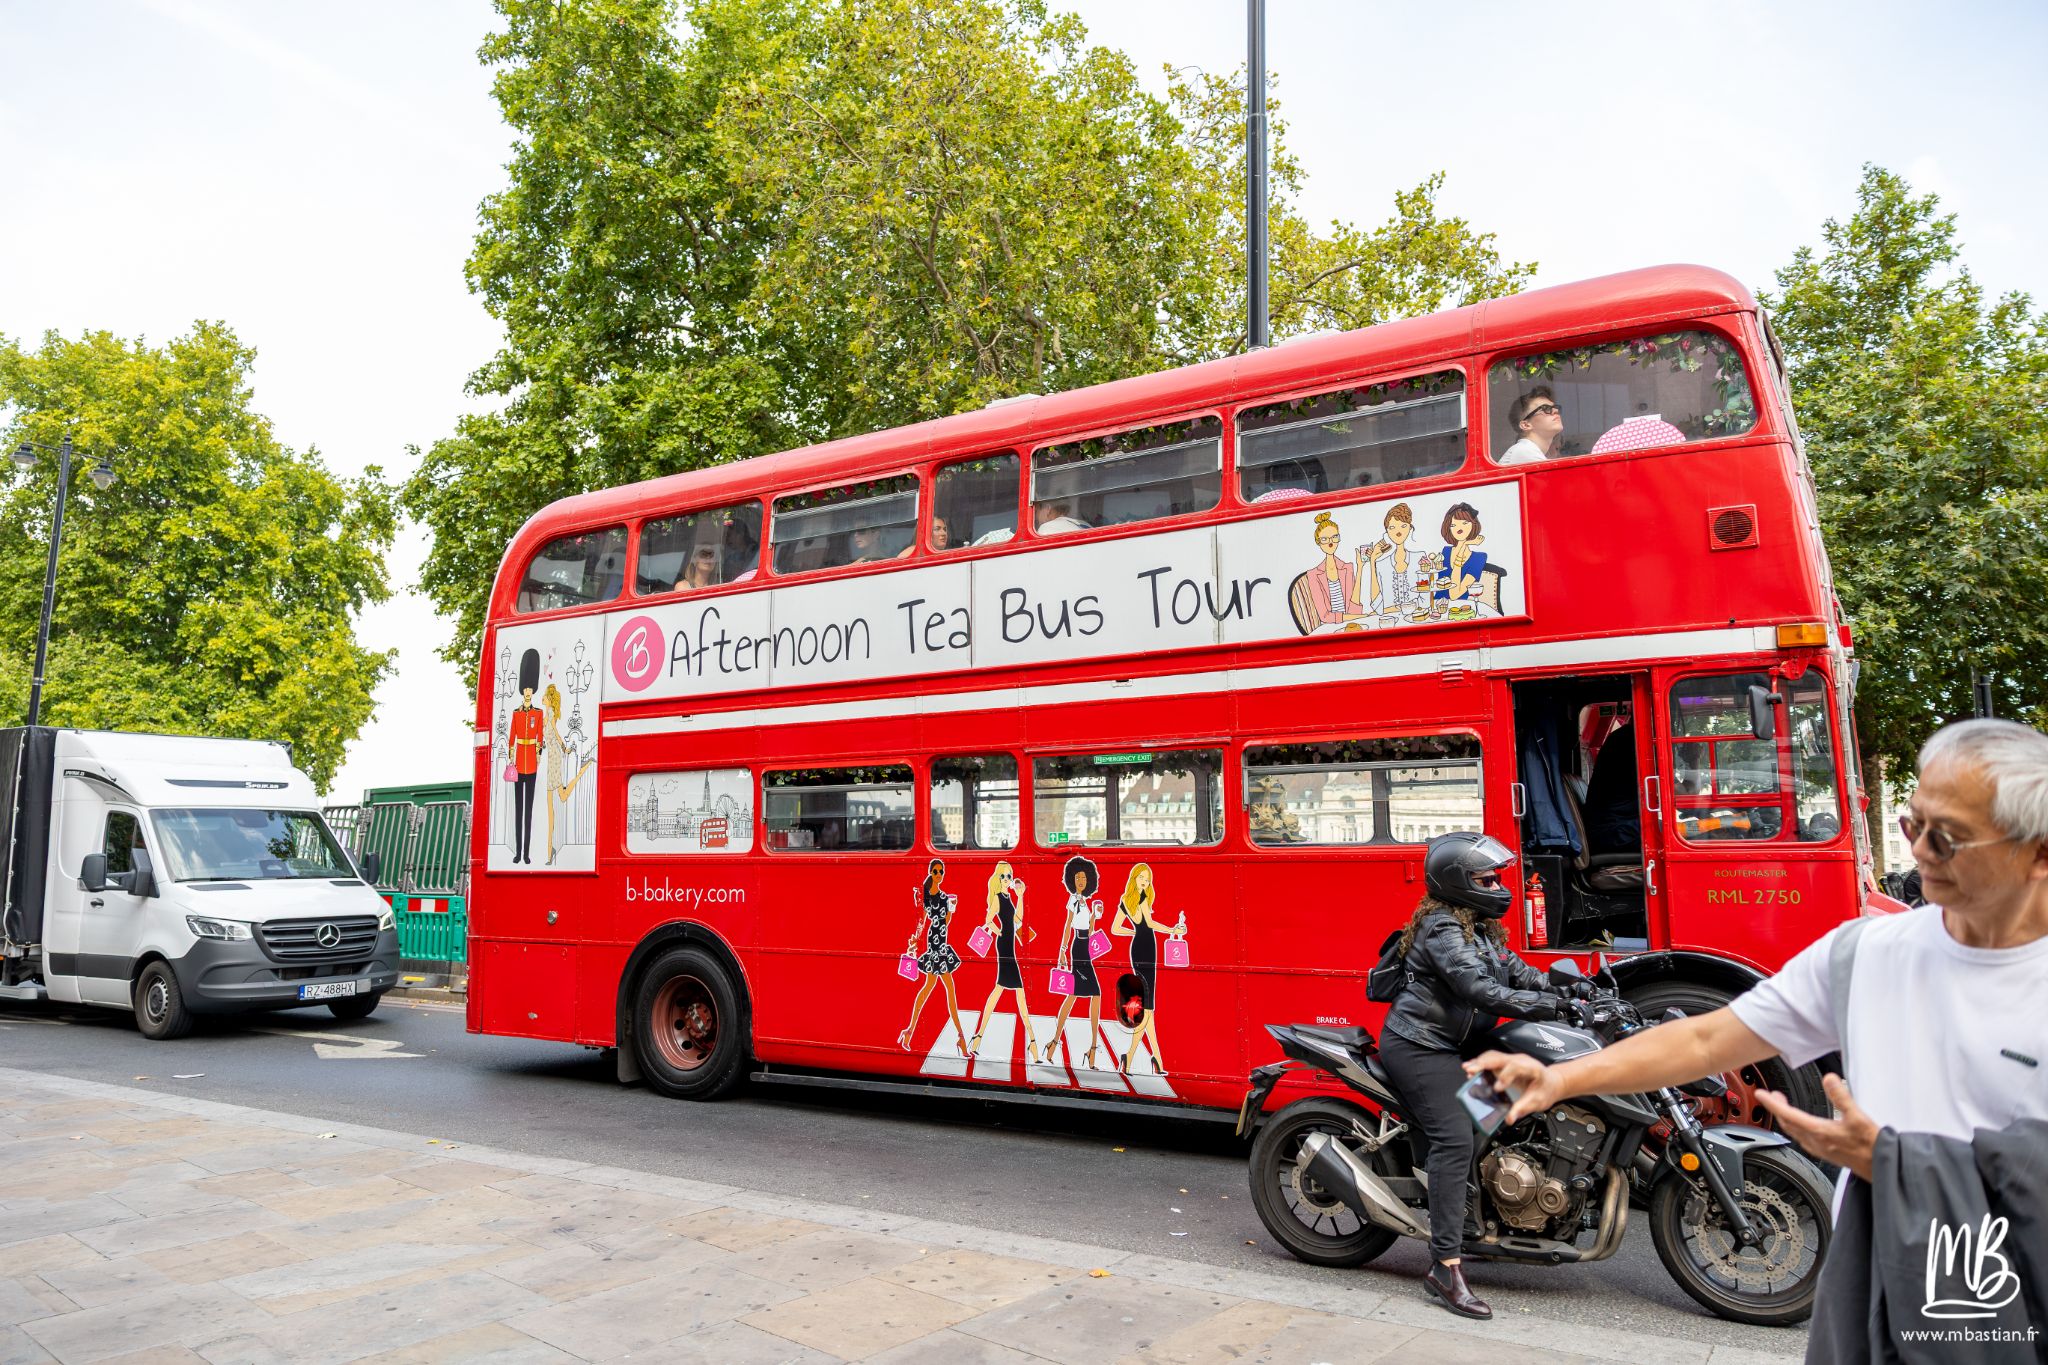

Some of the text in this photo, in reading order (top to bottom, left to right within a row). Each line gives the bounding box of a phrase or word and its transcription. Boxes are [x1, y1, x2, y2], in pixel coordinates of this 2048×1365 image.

[669, 606, 870, 678] Afternoon
[897, 598, 971, 655] Tea
[1000, 587, 1104, 643] Bus
[1137, 566, 1271, 628] Tour
[1102, 755, 1136, 763] EMERGENCY
[1714, 869, 1788, 878] ROUTEMASTER
[625, 876, 746, 910] b-bakery.com
[1707, 889, 1801, 905] RML 2750
[306, 983, 353, 997] RZ 488HX
[1316, 1016, 1338, 1024] BRAKE
[1535, 1042, 1566, 1053] HONDA
